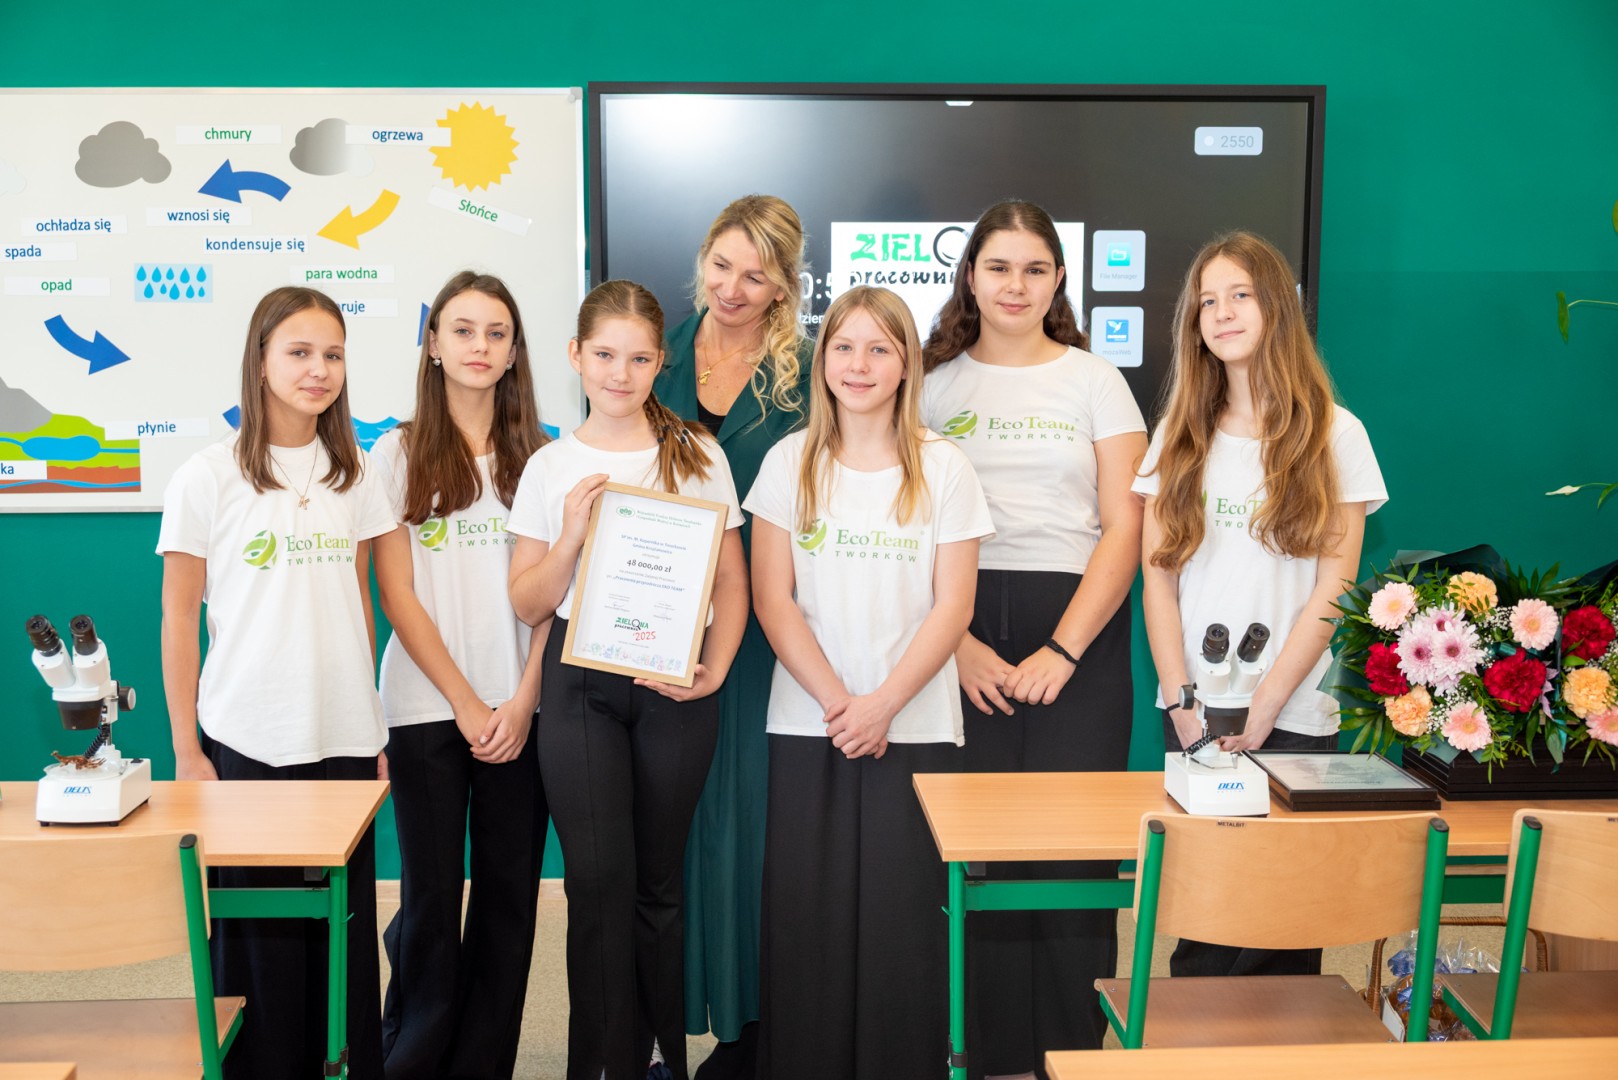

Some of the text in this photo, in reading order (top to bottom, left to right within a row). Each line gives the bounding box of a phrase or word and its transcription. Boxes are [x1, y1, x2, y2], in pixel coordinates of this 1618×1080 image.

[204, 127, 252, 142] chmury
[371, 130, 424, 144] ogrzewa
[1220, 135, 1255, 148] 2550
[167, 209, 231, 224] wznosi się
[458, 199, 499, 222] Słońce
[36, 217, 112, 232] ochładza się
[4, 244, 42, 257] spada
[206, 237, 305, 253] kondensuje się
[305, 266, 378, 282] para wodna
[1100, 272, 1137, 281] File Manager
[41, 278, 73, 293] opad
[137, 421, 177, 436] płynie
[987, 415, 1076, 432] EcoTeam
[836, 528, 920, 551] EcoTeam
[287, 554, 353, 567] TWORKÓW
[835, 550, 918, 563] TWORKÓW
[626, 559, 672, 573] 48 000,00 zł
